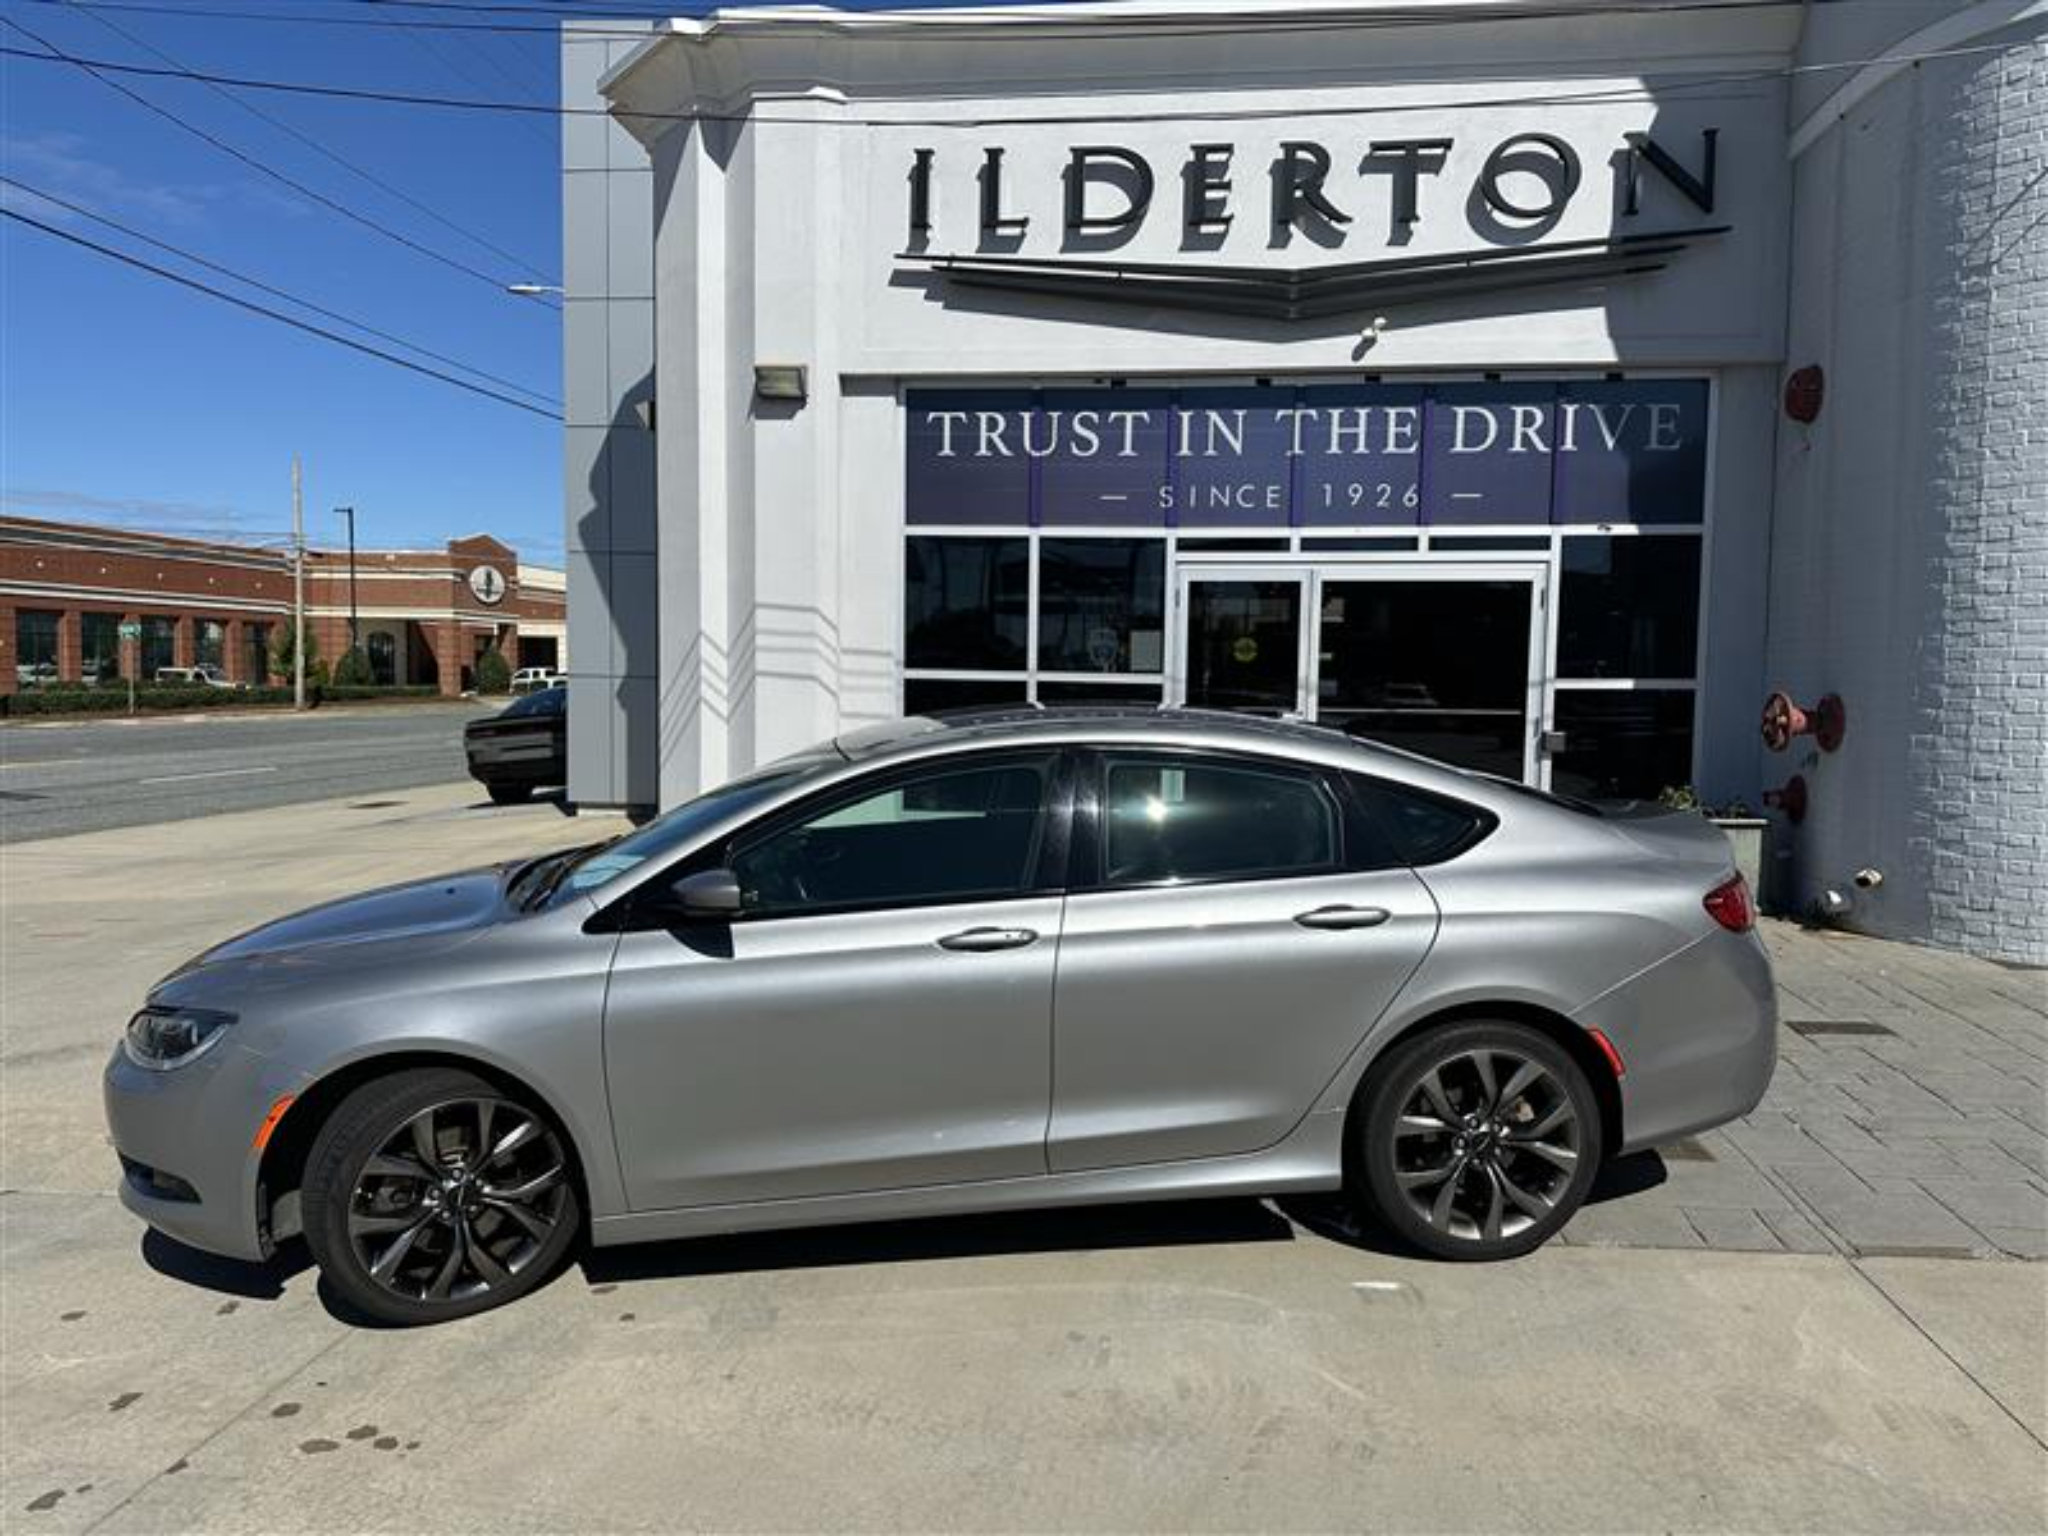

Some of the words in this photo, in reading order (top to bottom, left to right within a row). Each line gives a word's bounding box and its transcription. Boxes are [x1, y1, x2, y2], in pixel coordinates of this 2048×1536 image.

[907, 128, 1721, 232] ILDERTON
[926, 410, 1151, 458] TRUST
[1175, 409, 1248, 457] IN
[1274, 406, 1419, 457] THE
[1449, 402, 1683, 454] DRIVE
[1159, 483, 1282, 509] SINCE
[1322, 482, 1420, 508] 1926
